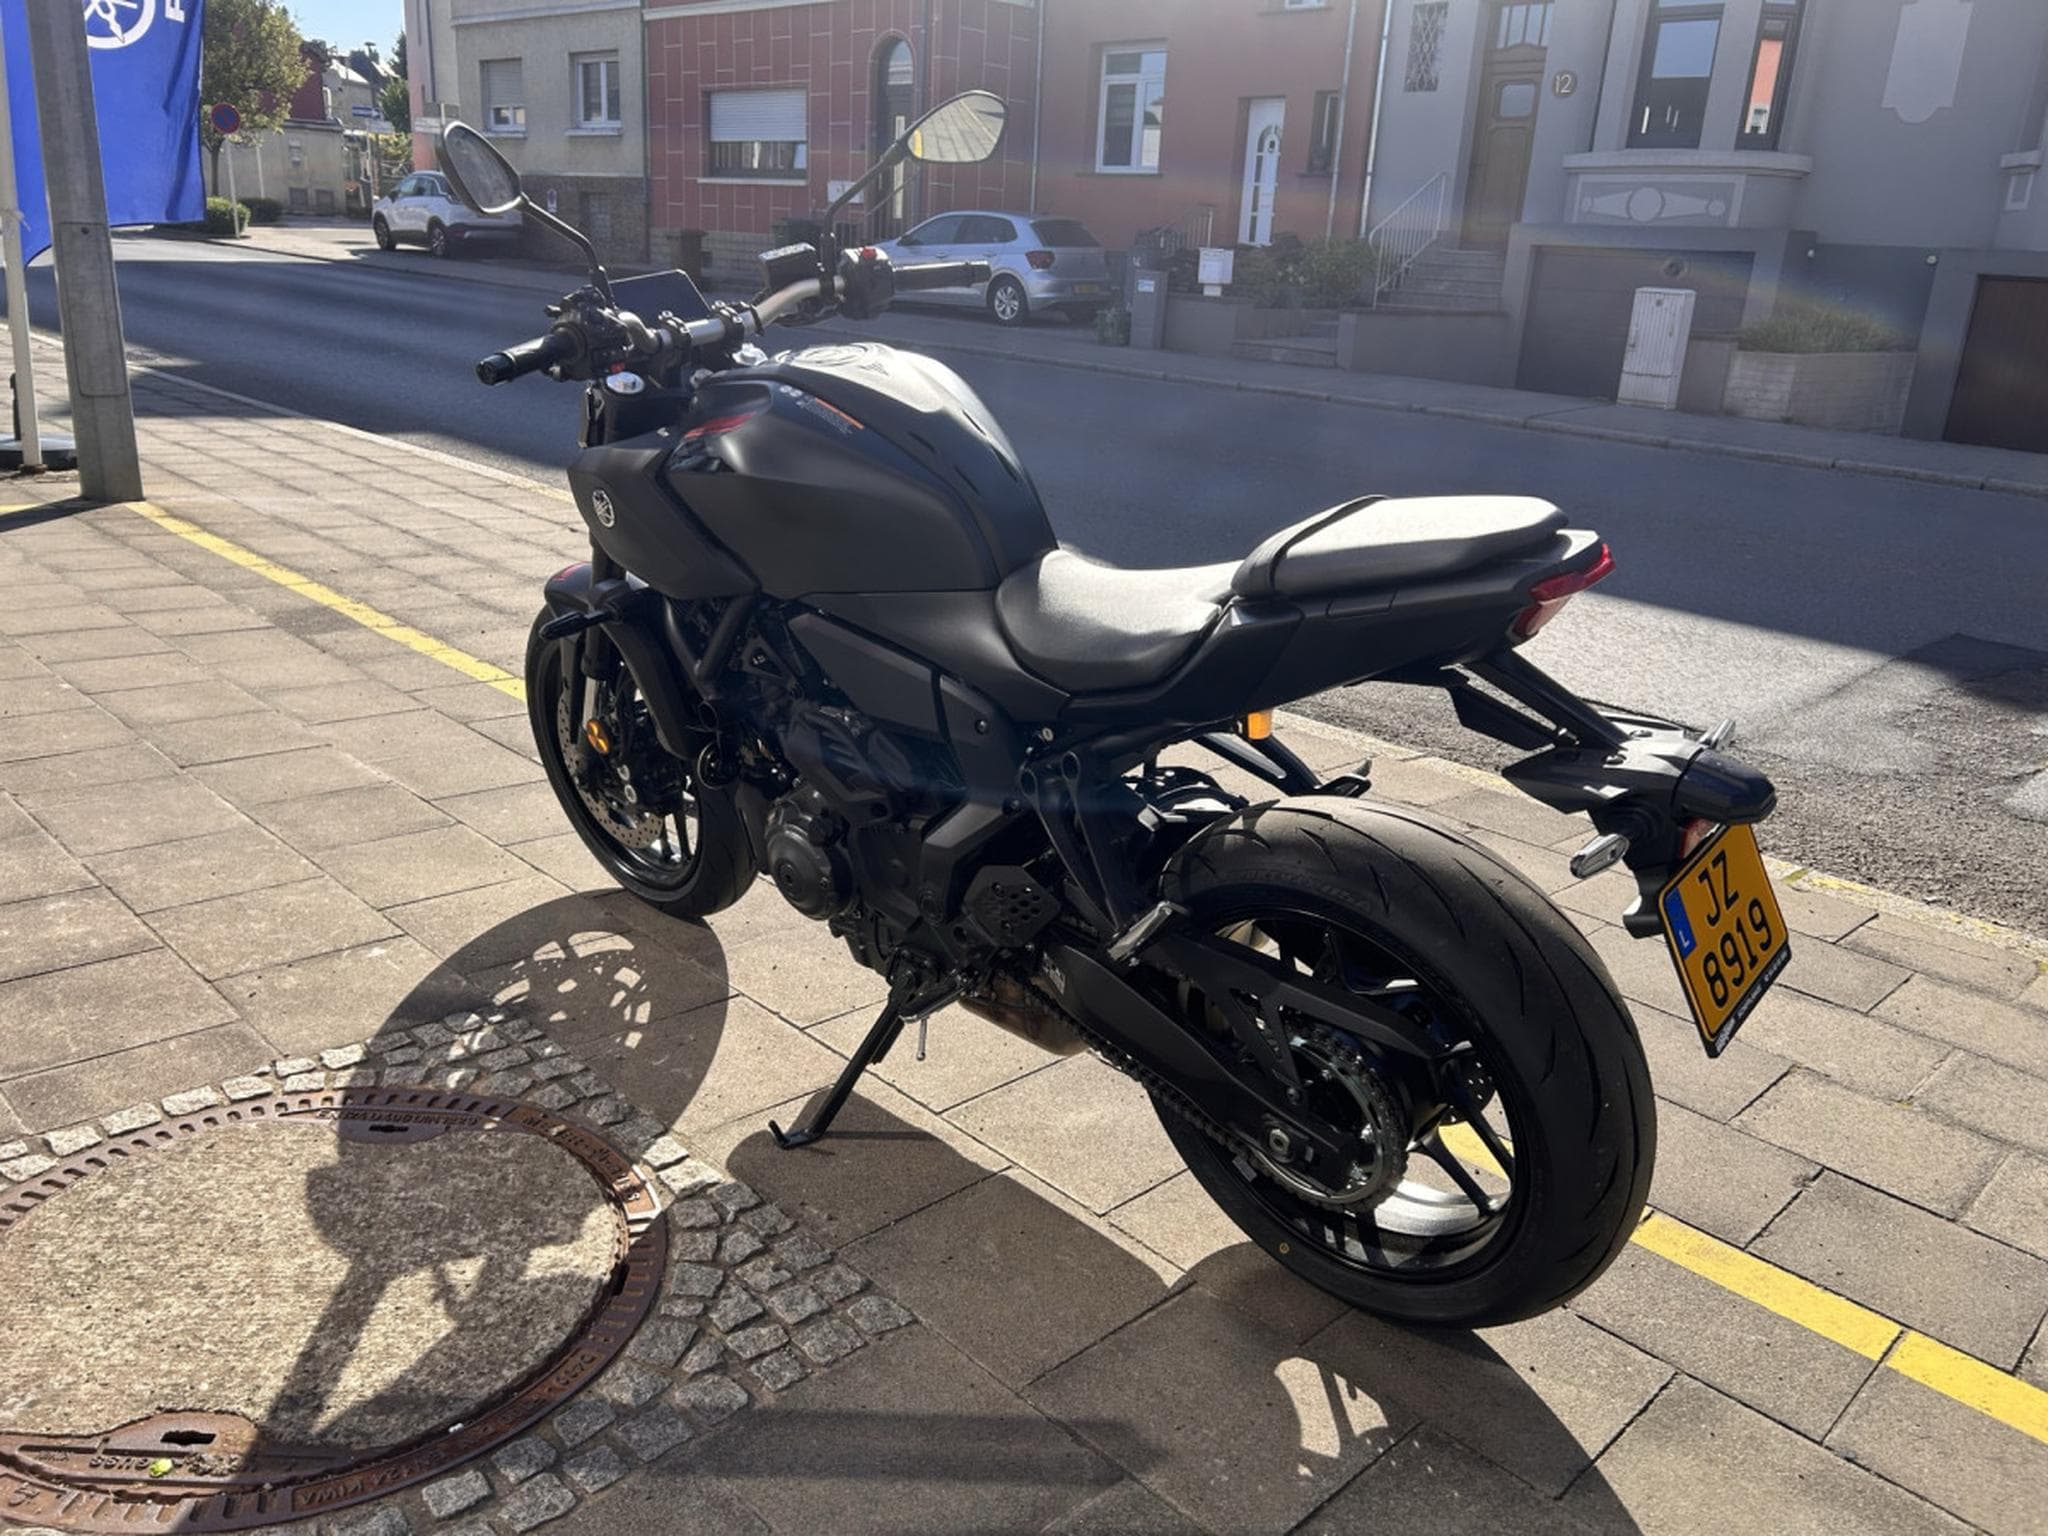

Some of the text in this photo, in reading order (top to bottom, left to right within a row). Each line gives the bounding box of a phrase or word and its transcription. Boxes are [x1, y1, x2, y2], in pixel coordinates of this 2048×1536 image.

[1555, 73, 1573, 94] 12
[1697, 849, 1740, 928] JZ
[1678, 929, 1690, 949] L
[1702, 896, 1773, 1010] 8919
